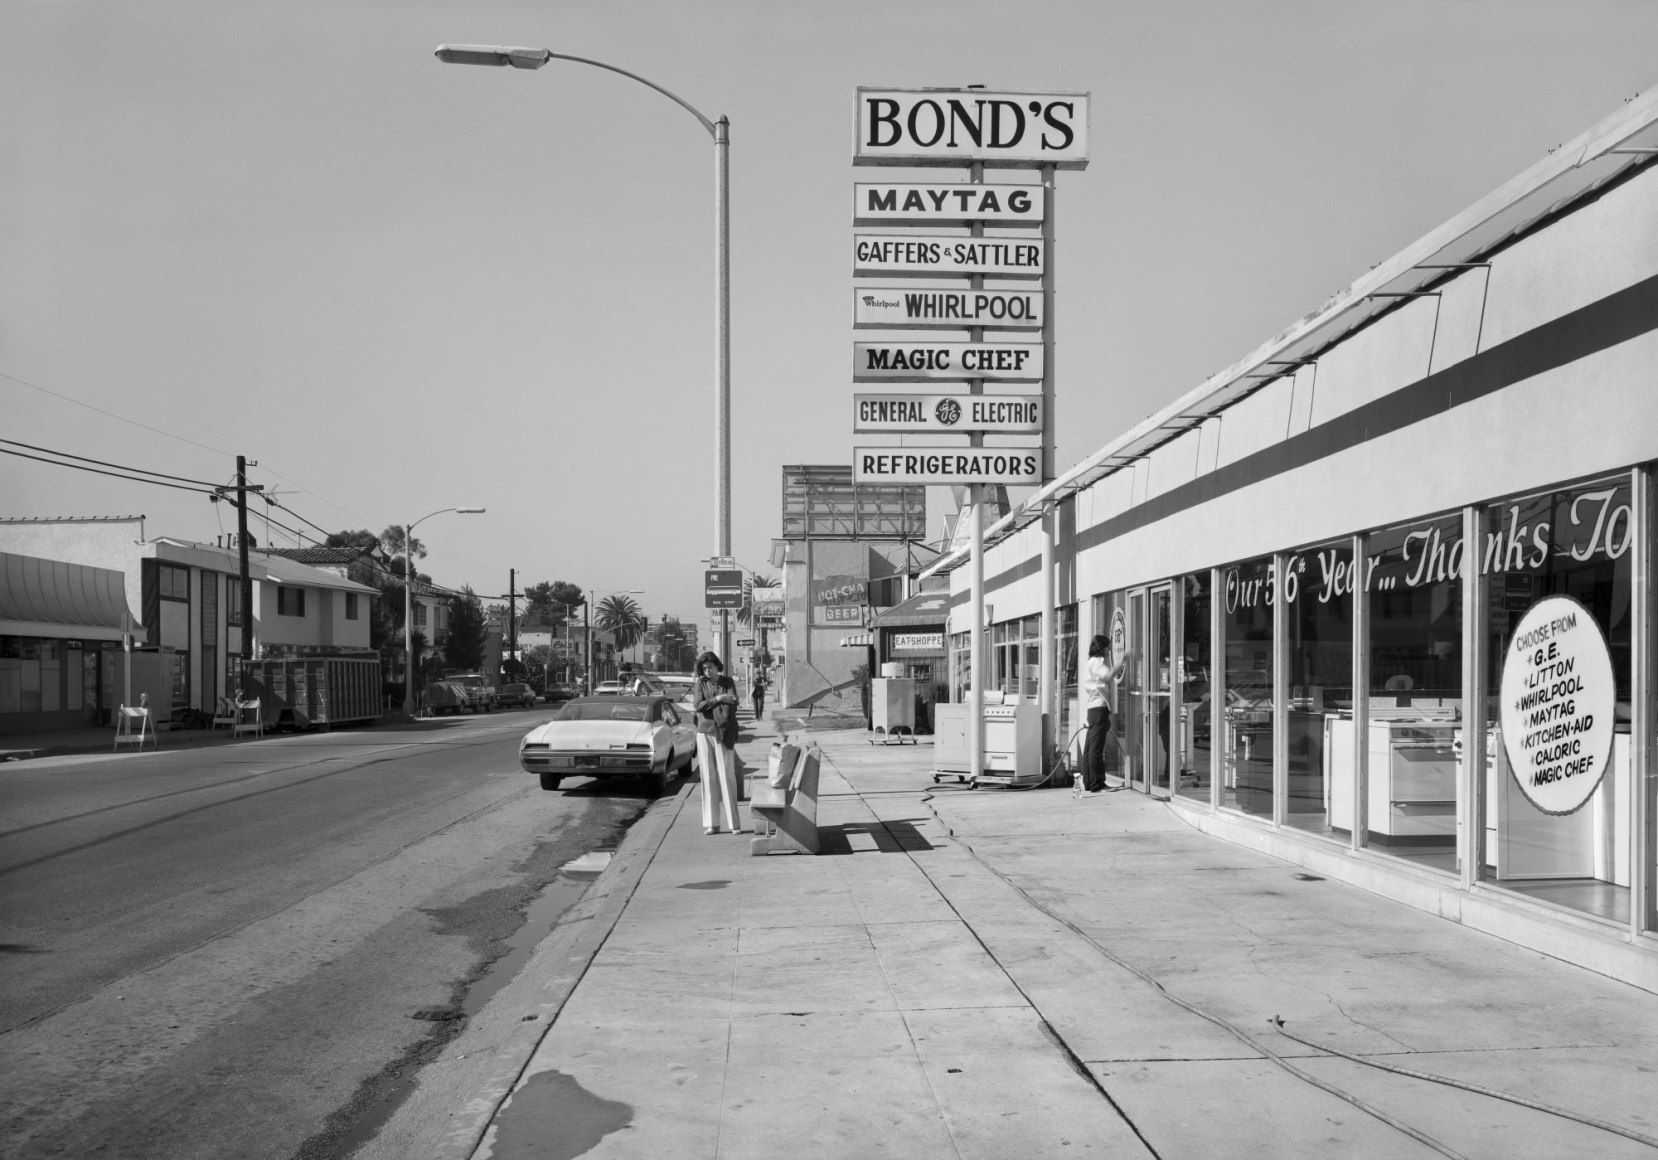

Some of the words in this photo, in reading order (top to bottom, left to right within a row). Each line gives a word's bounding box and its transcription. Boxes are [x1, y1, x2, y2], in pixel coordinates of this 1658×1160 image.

[866, 98, 1074, 150] BOND'S
[868, 189, 1032, 213] MAYTAG
[857, 241, 941, 264] GAFFERS
[943, 247, 952, 257] &
[953, 243, 1040, 267] SATTLER
[865, 299, 900, 309] Whirlpool
[905, 293, 1037, 320] WHIRLPOOL
[866, 348, 951, 370] MAGIC
[961, 349, 1030, 371] CHEF
[860, 401, 927, 422] GENERAL
[972, 402, 1037, 423] ELECTRIC
[863, 455, 1037, 475] REFRIGERATORS
[1225, 569, 1263, 615] Our
[1402, 505, 1550, 587] Thanks
[1570, 486, 1633, 561] To
[827, 608, 858, 620] BEER
[1516, 624, 1550, 652] CHOOSE
[1550, 612, 1577, 637] FROM
[1534, 642, 1560, 667] G.E.
[1529, 656, 1575, 689] LITTON
[1520, 675, 1584, 712] WHIRLPOOL
[1529, 699, 1576, 729] MAYTAG
[1535, 739, 1581, 766] CALORIC
[1533, 764, 1562, 787] MAGIC
[1564, 755, 1594, 778] CHEF
